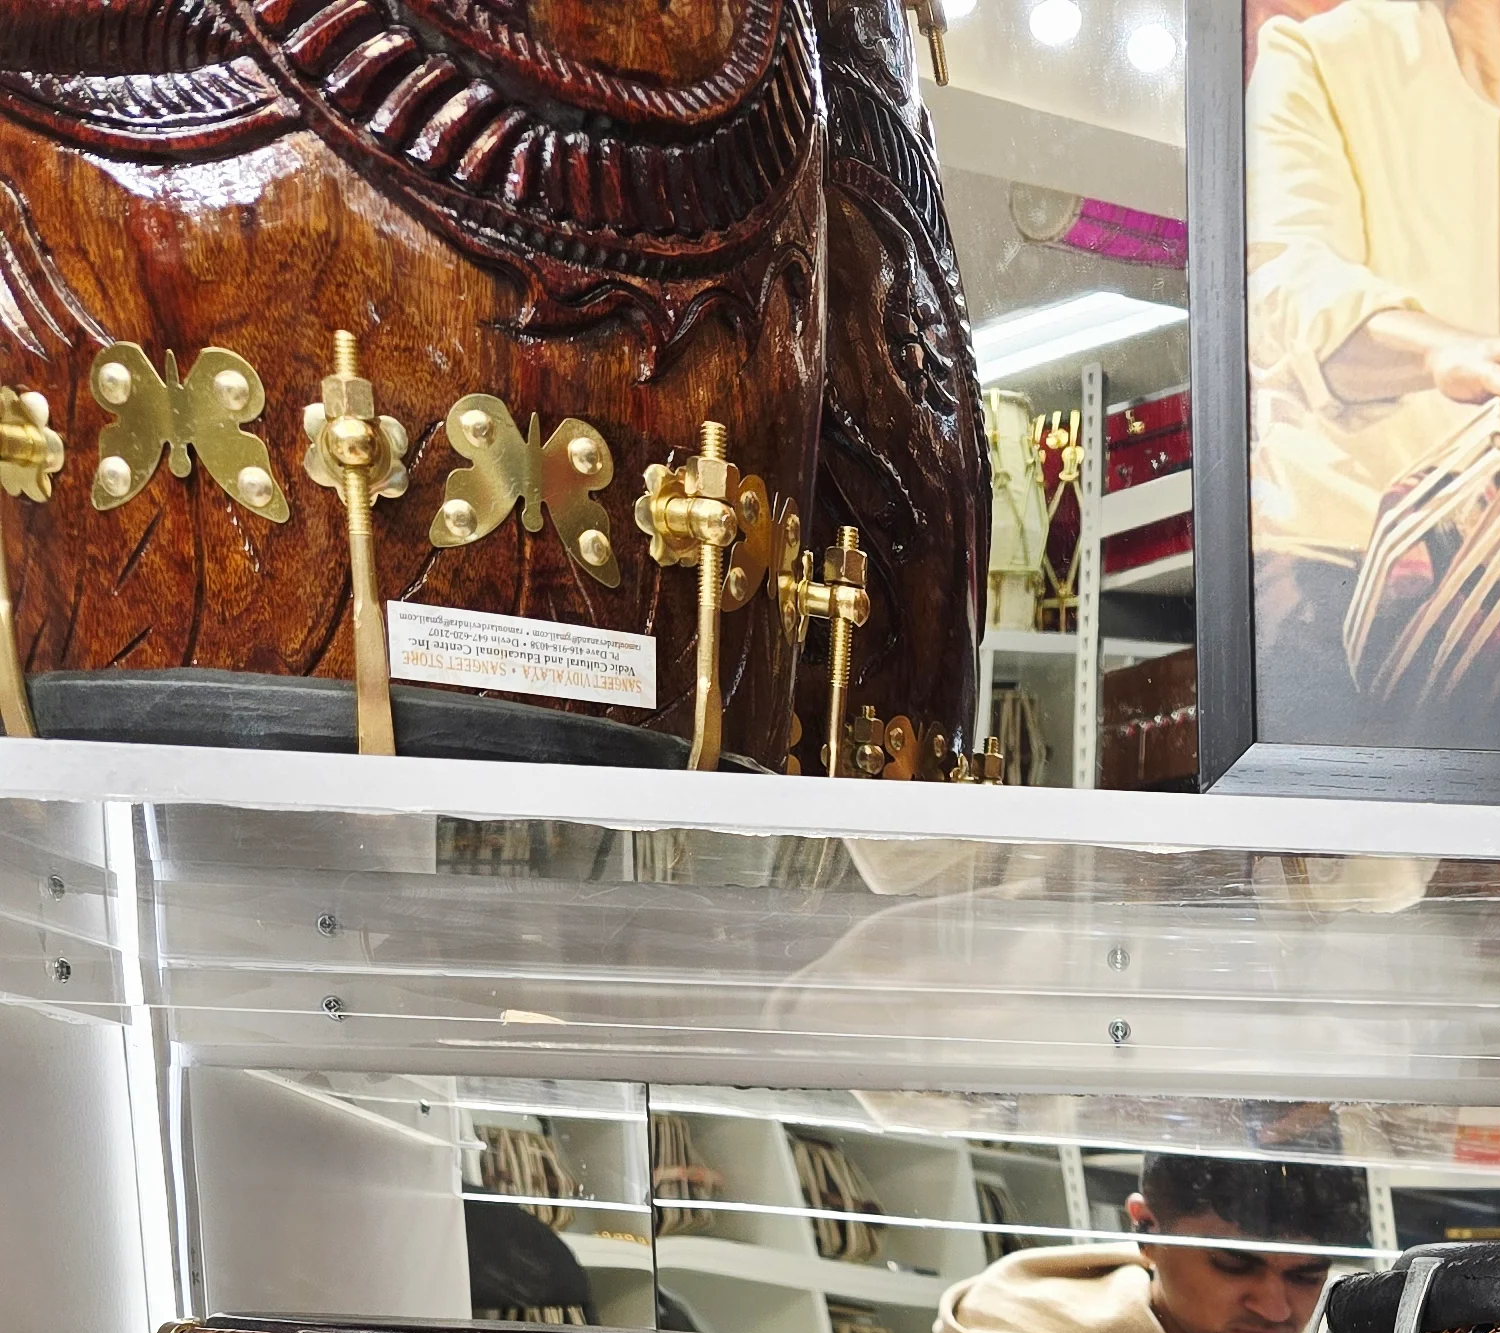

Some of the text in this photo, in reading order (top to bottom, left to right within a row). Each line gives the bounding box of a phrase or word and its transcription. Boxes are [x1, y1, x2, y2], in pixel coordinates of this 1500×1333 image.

[399, 612, 641, 651] ramoutardevanand@gmail.com ramoutardevindra@gmail.com
[428, 627, 488, 642] 647-620-2107
[490, 635, 520, 648] Devin
[530, 640, 585, 655] 416-918-4038
[408, 637, 636, 677] Vedic Cultural and Educational Centre Inc.
[585, 647, 607, 660] Dave
[402, 650, 642, 694] SANGEET VIDYALAYA SANGEET STORE
